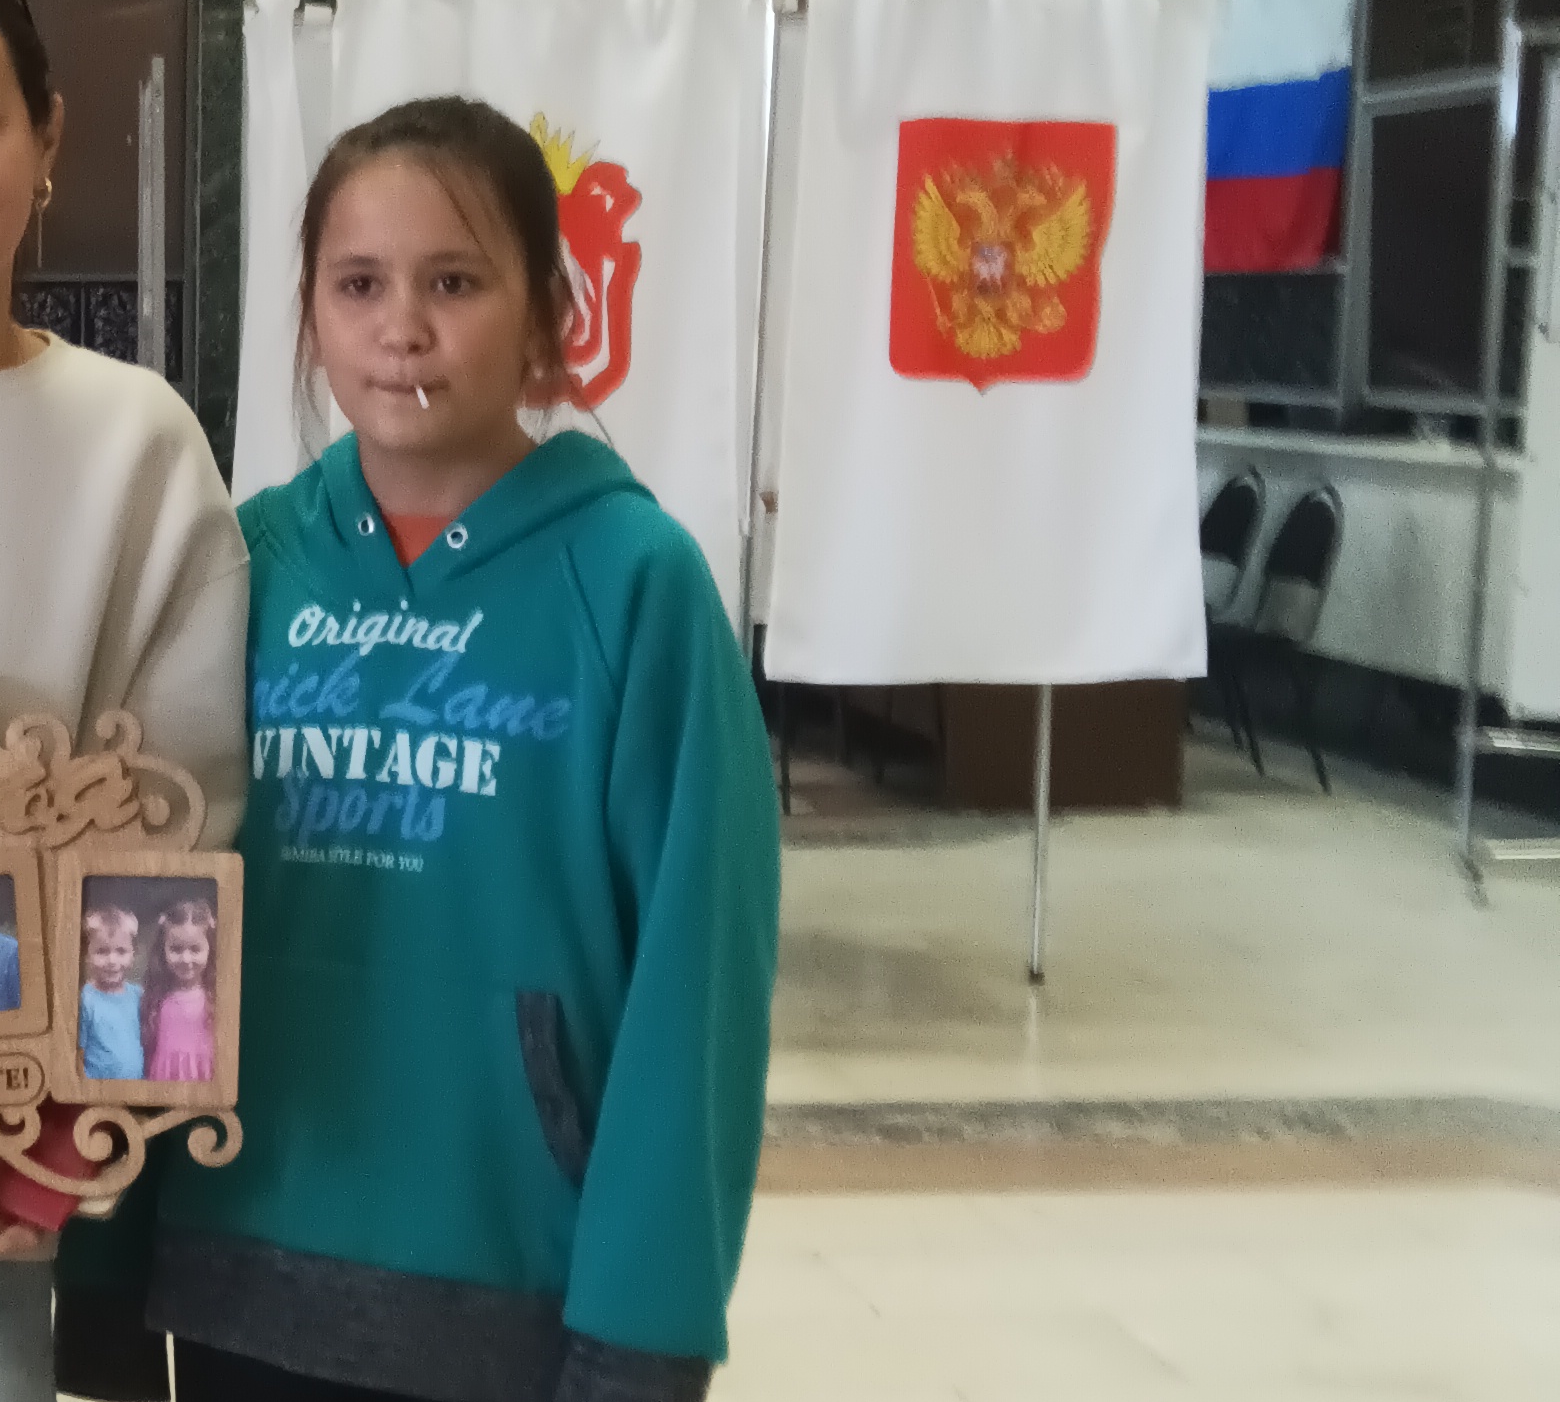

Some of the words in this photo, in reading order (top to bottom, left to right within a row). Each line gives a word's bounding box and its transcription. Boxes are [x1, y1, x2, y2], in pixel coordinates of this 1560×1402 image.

[288, 598, 484, 657] Original
[380, 650, 572, 740] Lane
[253, 725, 502, 797] VINTAGE
